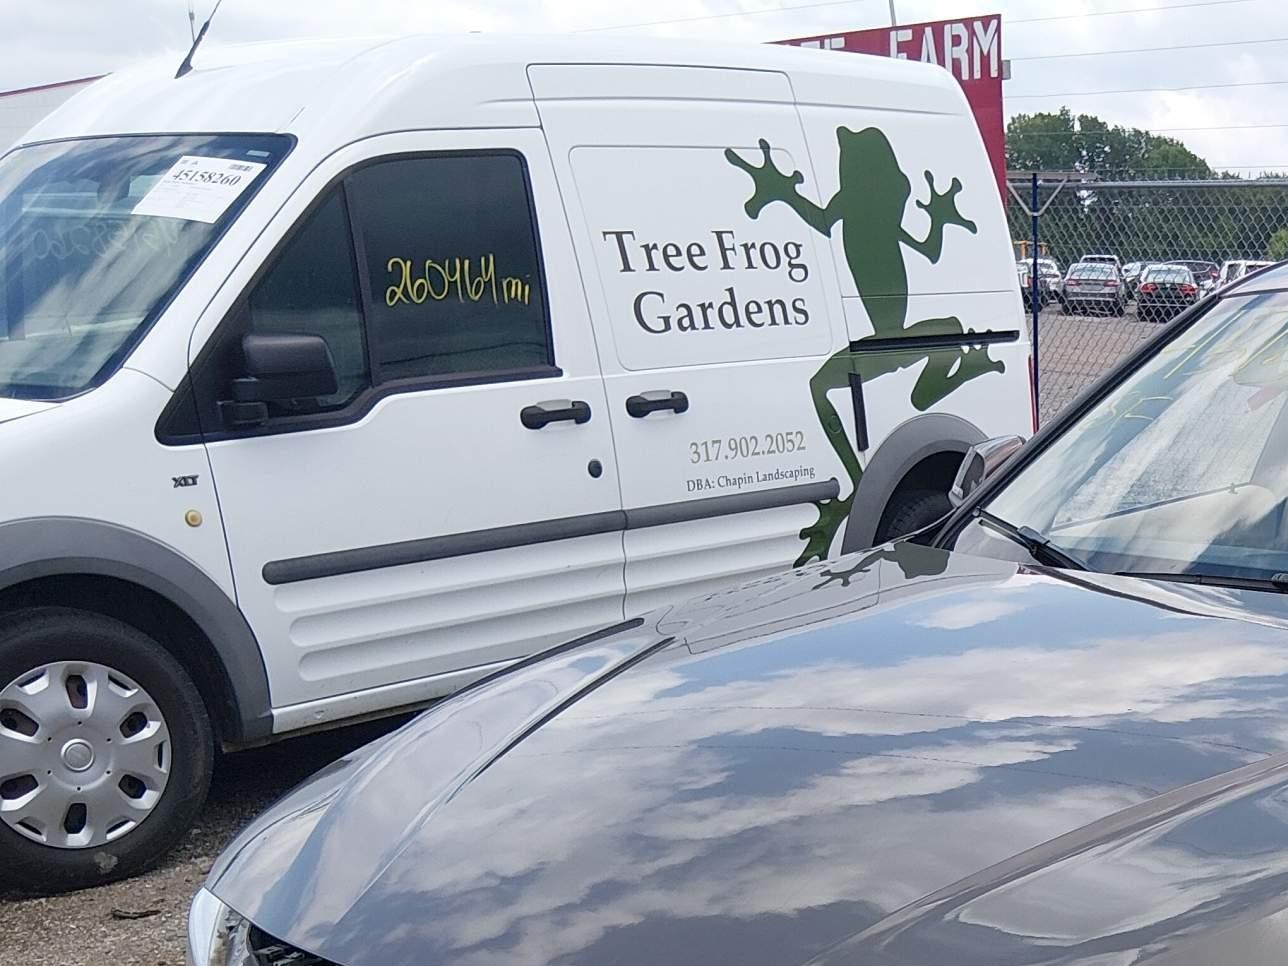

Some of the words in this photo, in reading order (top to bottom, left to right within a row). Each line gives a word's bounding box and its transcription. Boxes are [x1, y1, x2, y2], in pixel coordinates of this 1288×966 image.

[172, 168, 242, 186] 45158260
[602, 231, 709, 273] Tree
[712, 230, 809, 283] Frog
[386, 254, 498, 306] 260464
[502, 274, 531, 305] mi
[633, 287, 809, 334] Gardens
[689, 430, 807, 464] 317.902.2052
[686, 478, 715, 492] DBA:
[717, 473, 754, 488] Chapin
[756, 465, 815, 483] Landscaping
